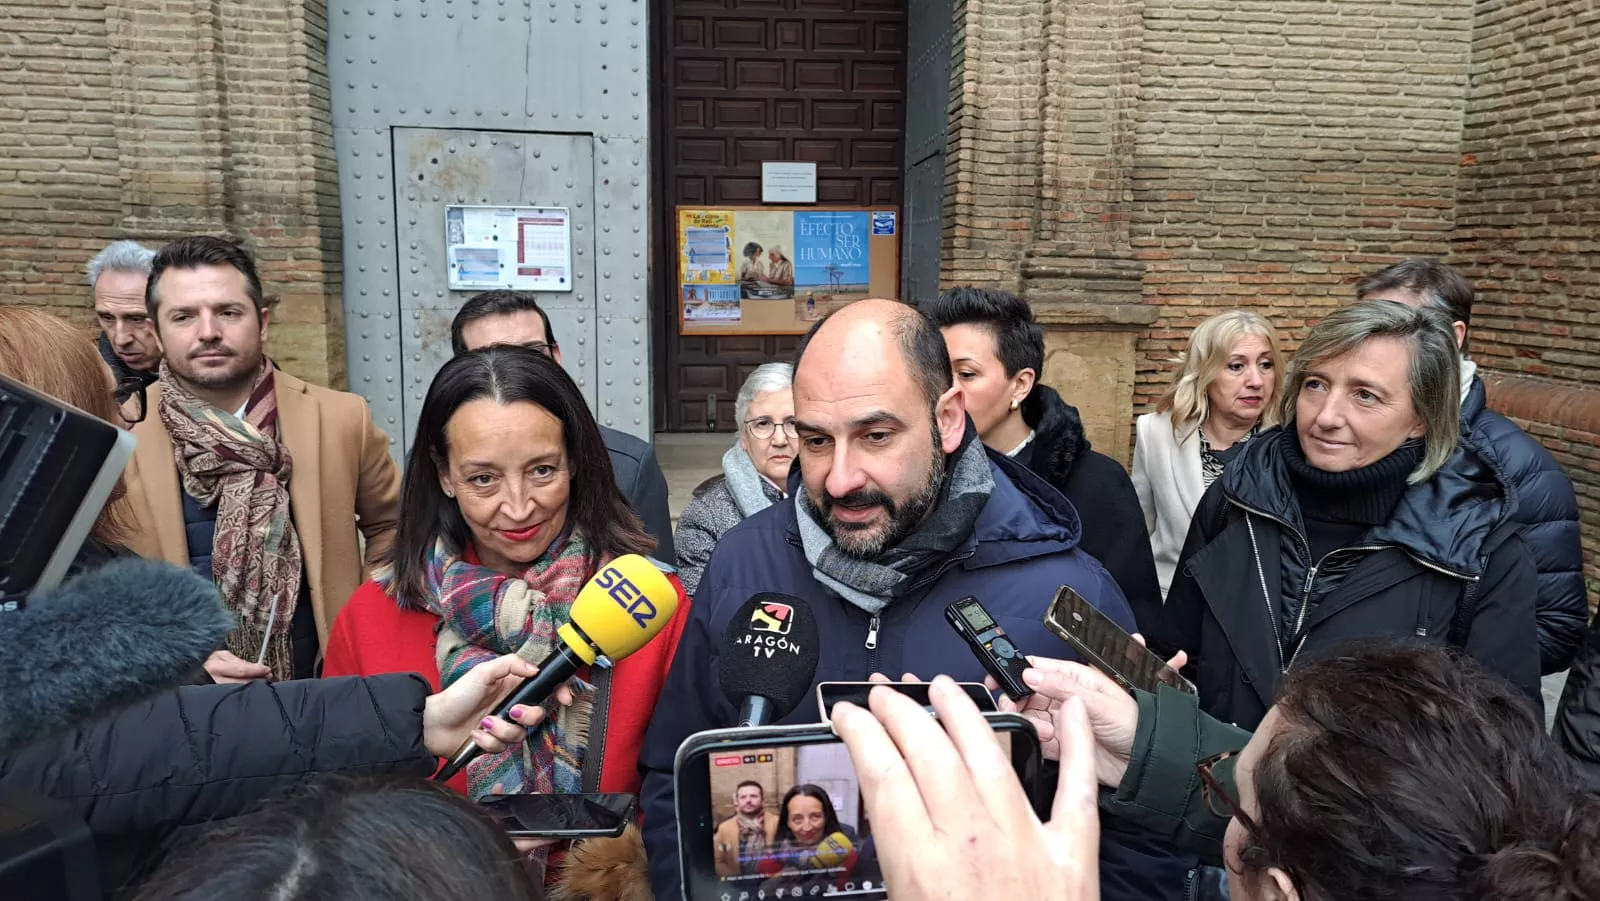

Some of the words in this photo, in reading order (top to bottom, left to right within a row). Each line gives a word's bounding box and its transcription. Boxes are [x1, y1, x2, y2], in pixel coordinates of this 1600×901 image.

[800, 221, 854, 236] EFECTO
[836, 234, 860, 248] SER
[800, 247, 862, 261] HUMANO
[595, 567, 656, 629] SER
[753, 646, 775, 659] TV
